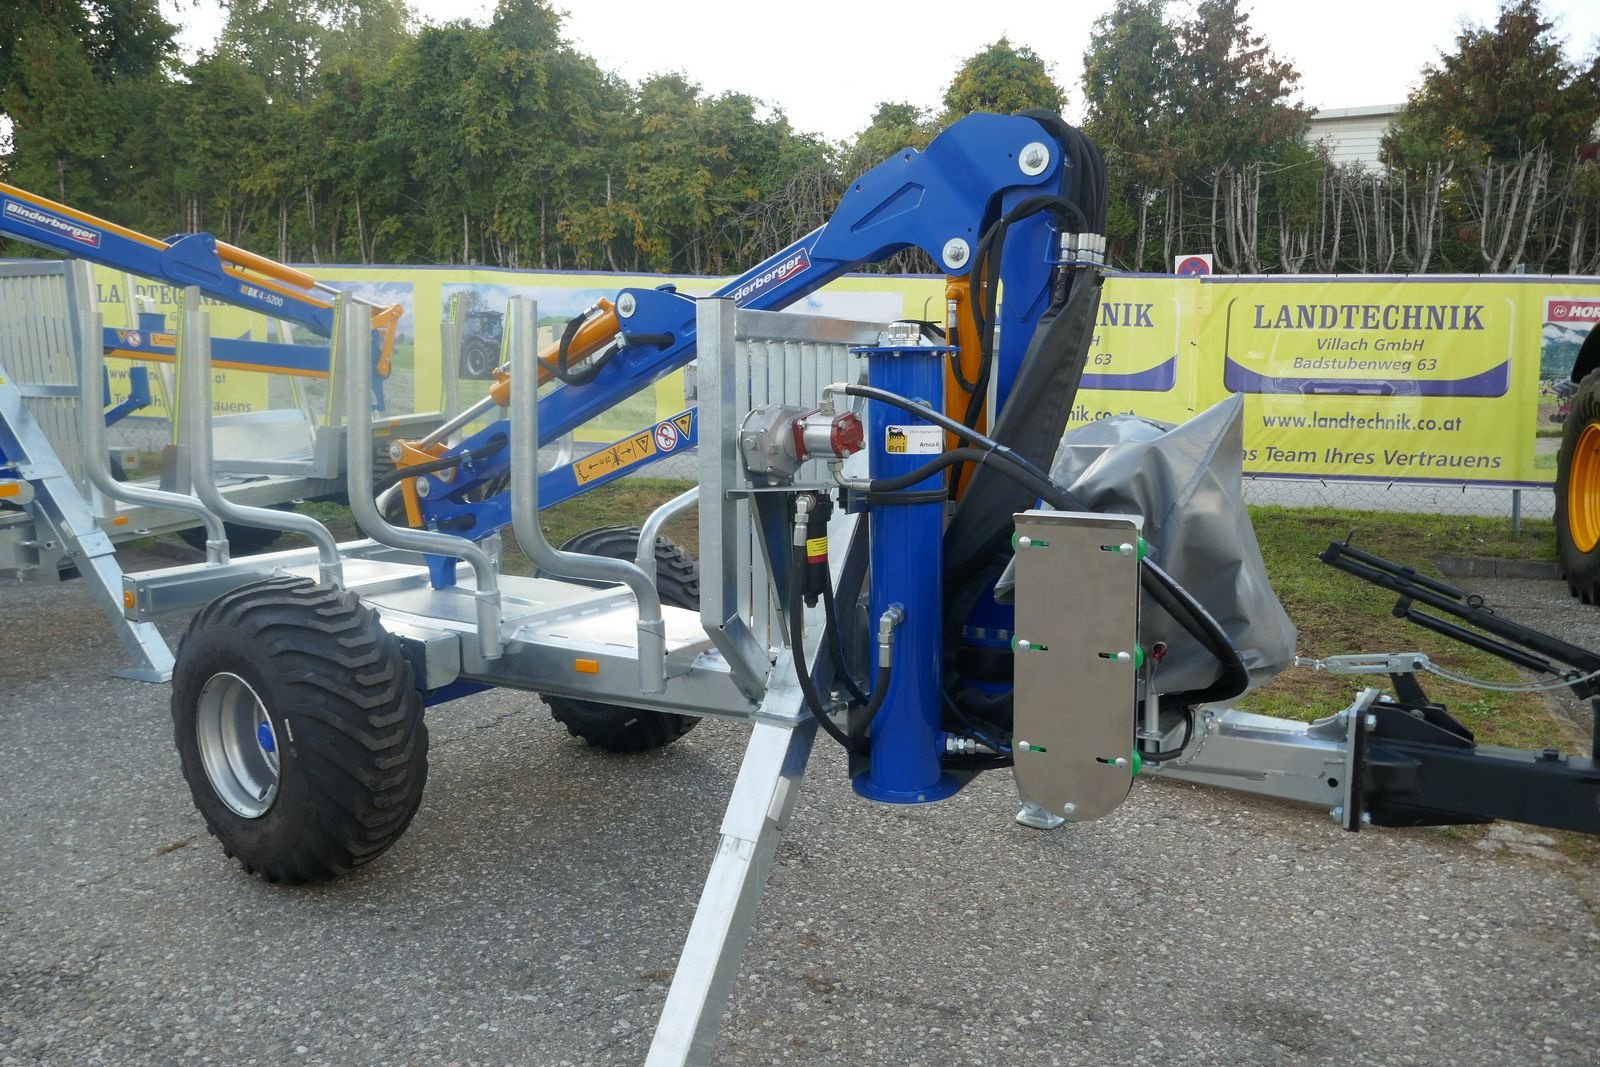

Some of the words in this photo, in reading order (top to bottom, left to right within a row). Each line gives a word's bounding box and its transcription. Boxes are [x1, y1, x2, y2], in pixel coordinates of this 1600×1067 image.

[6, 203, 96, 238] Binderberger
[731, 255, 801, 300] derberger
[1095, 303, 1154, 327] NIK
[1253, 304, 1485, 330] LANDTECHNIK
[1316, 338, 1369, 352] Villach
[1374, 338, 1425, 352] GmbH
[1094, 353, 1112, 365] 63
[1293, 357, 1411, 373] Badstubenweg
[1417, 358, 1437, 371] 63
[1263, 411, 1462, 431] www.landtechnik.co.at
[888, 442, 905, 452] eni
[1265, 446, 1317, 463] Team
[1323, 448, 1375, 465] Ihres
[1383, 450, 1501, 469] Vertrauens
